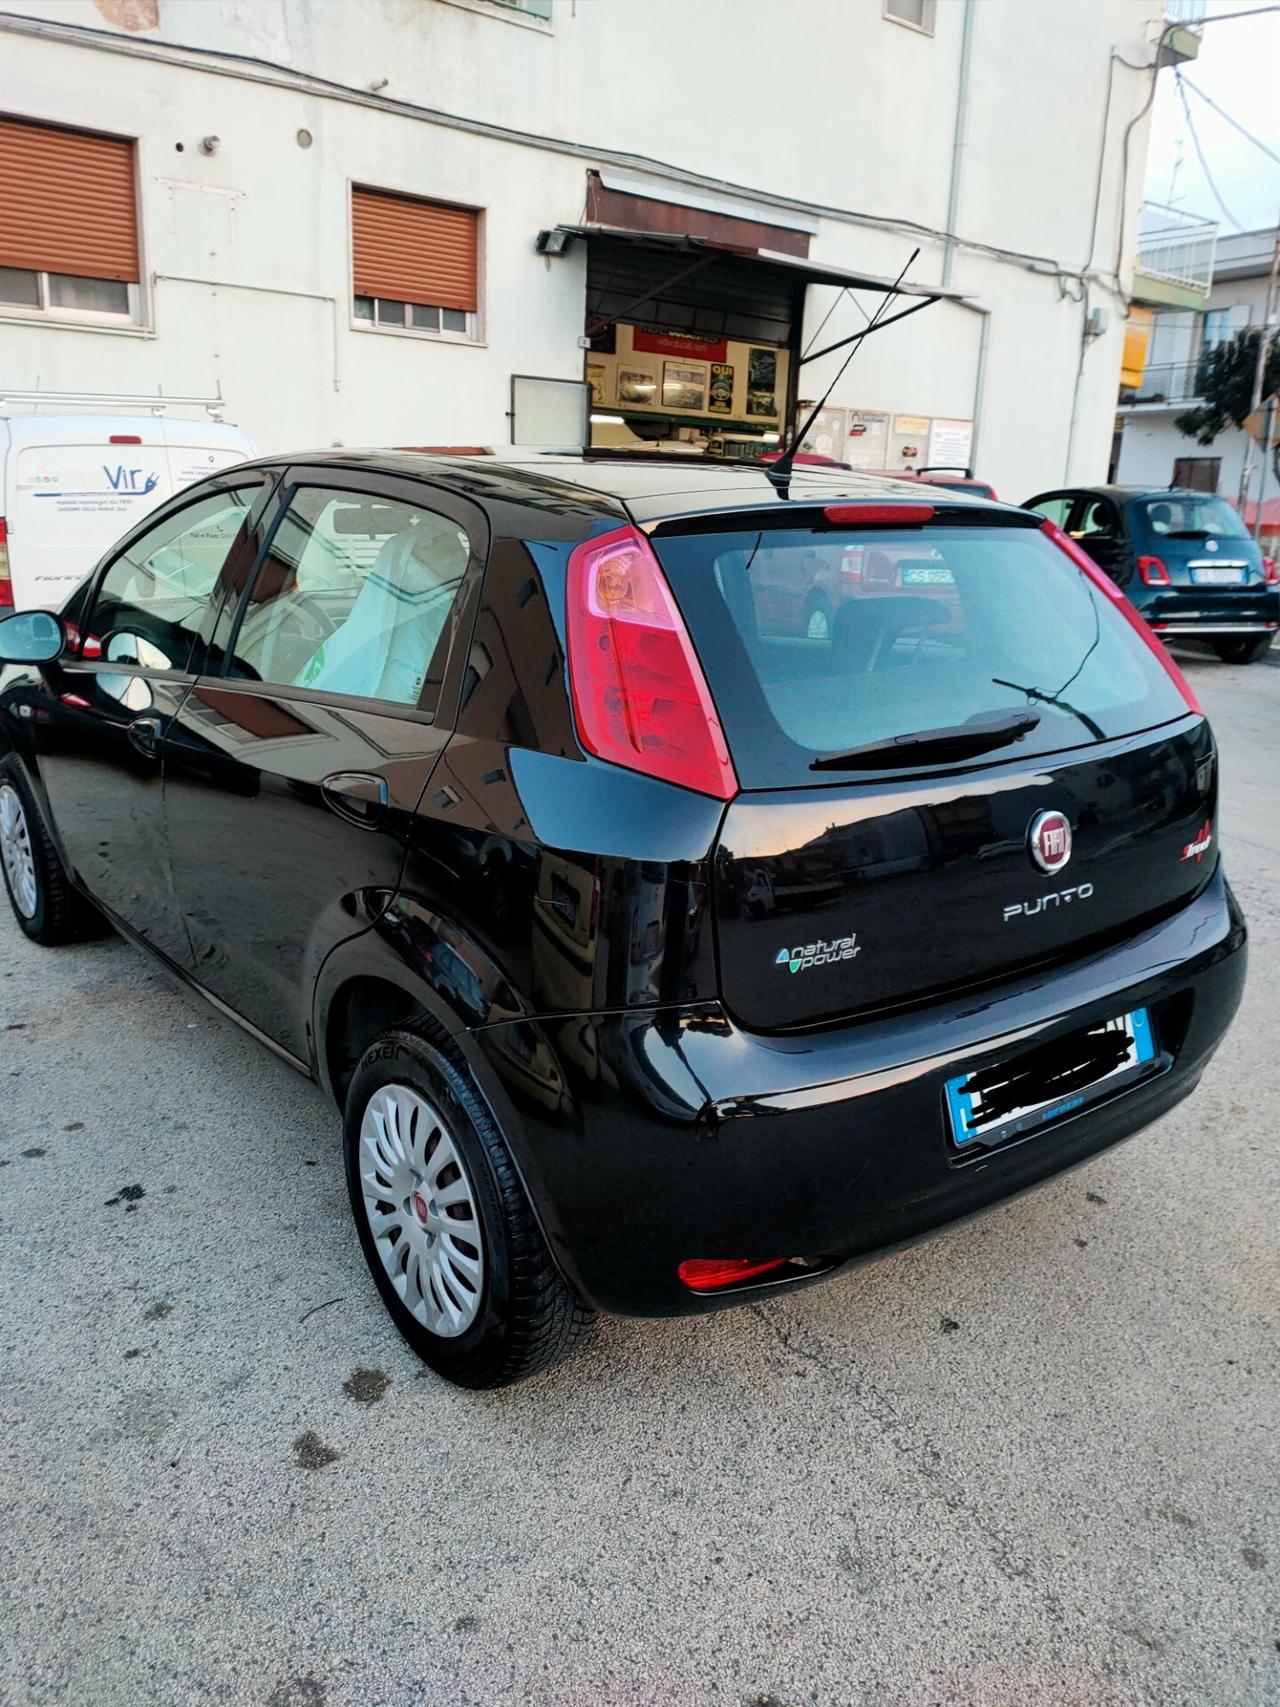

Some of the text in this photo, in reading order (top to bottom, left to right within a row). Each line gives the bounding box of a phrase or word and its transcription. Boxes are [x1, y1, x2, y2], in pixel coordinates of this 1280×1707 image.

[1043, 827, 1065, 857] FIAT
[1003, 883, 1094, 922] PUNTO
[791, 933, 857, 958] natural
[800, 946, 861, 971] power
